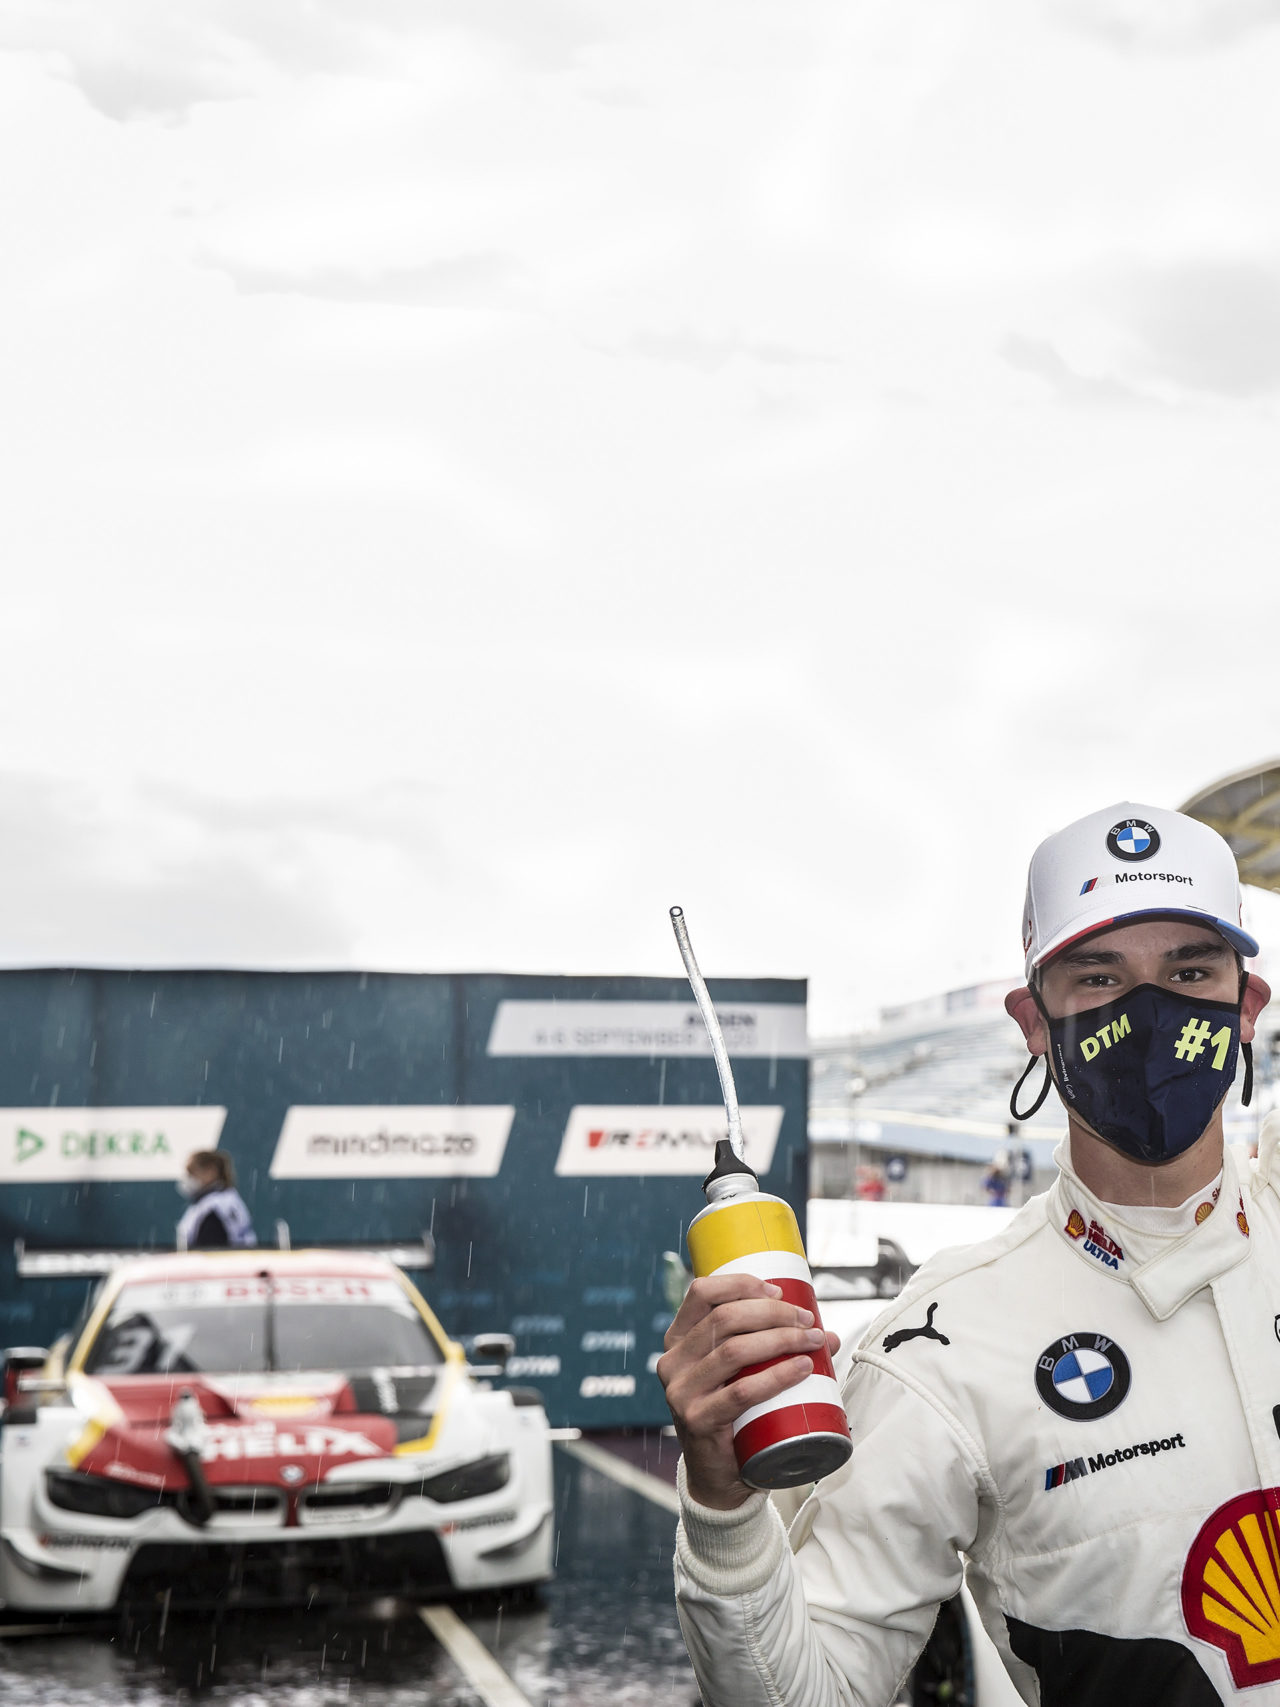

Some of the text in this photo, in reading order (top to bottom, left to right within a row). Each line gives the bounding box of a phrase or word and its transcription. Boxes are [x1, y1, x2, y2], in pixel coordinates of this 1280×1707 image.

[1110, 820, 1154, 836] BMW
[1115, 872, 1193, 886] Motorsport
[1079, 1013, 1132, 1062] DTM
[1174, 1017, 1232, 1071] #1
[62, 1130, 171, 1156] DEKRA
[306, 1129, 477, 1156] mindmaze
[608, 1129, 748, 1148] REMU
[1083, 1239, 1119, 1270] ULTRA
[225, 1282, 371, 1300] BOSCH
[1038, 1334, 1113, 1371] BMW
[202, 1430, 385, 1462] HELIX
[1088, 1433, 1185, 1473] Motorsport
